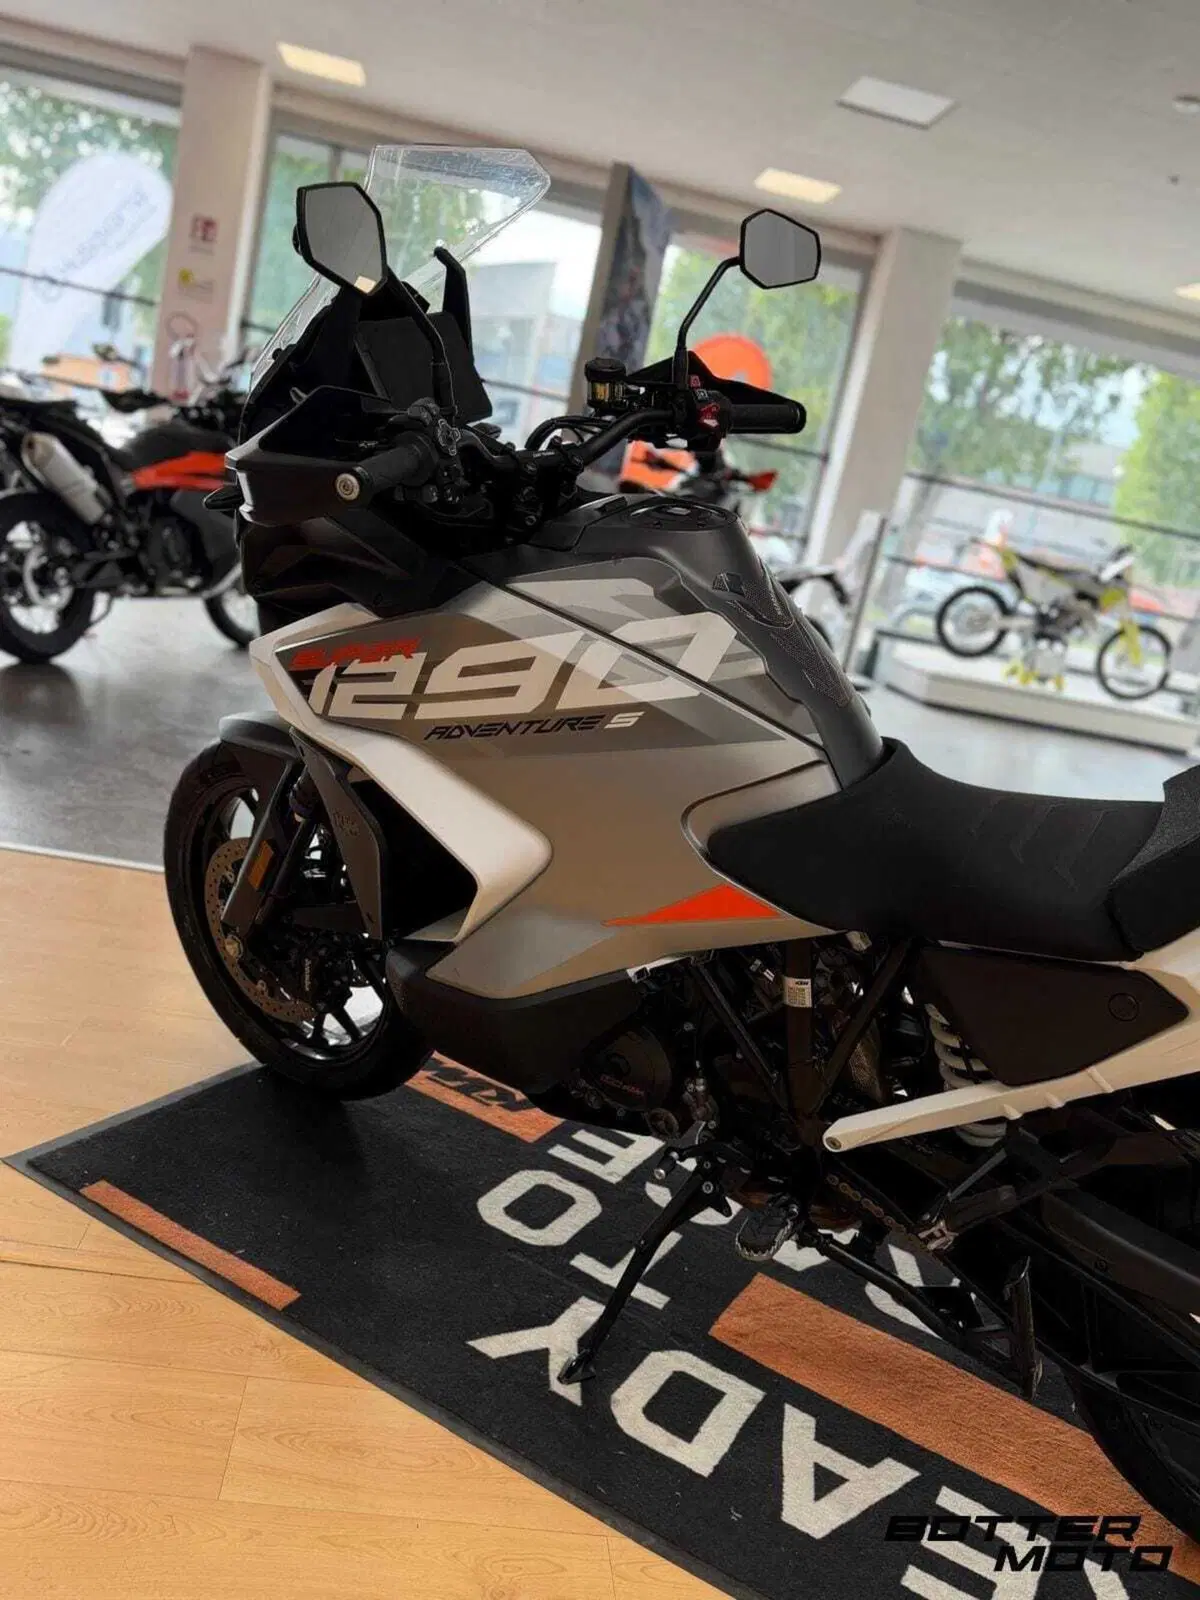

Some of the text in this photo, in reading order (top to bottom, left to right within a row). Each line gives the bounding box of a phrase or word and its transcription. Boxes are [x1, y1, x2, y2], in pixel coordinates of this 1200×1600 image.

[307, 611, 738, 721] 1290
[423, 711, 645, 741] ADVENTURE S
[477, 1169, 683, 1309] TO
